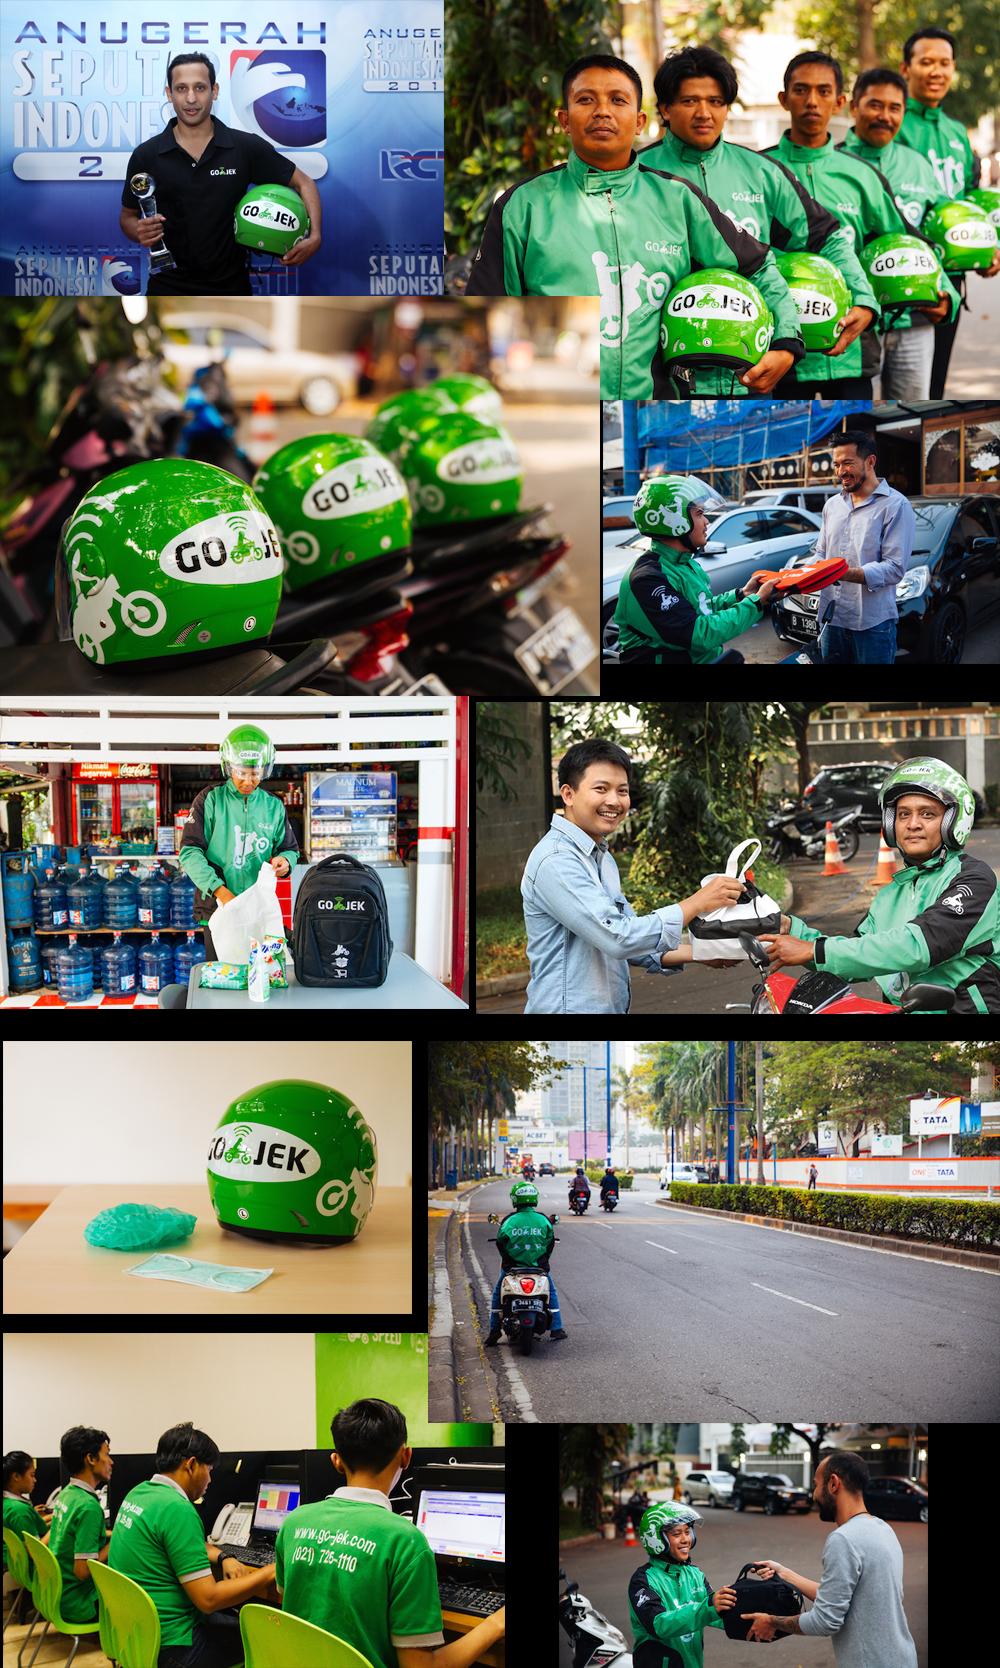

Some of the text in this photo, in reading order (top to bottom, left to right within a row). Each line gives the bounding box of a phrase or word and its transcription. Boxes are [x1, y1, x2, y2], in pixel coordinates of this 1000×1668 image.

[15, 21, 327, 44] ANUGERAH
[274, 211, 297, 229] JEK
[15, 256, 98, 276] SEPUTAR
[369, 256, 444, 274] SEPUTA
[875, 257, 895, 272] GO
[15, 278, 96, 296] INDONESIA
[672, 294, 752, 317] GO JEK
[803, 299, 831, 317] JEK
[312, 482, 350, 512] GO
[175, 536, 227, 573] GO
[318, 900, 366, 911] GO JEK
[789, 999, 814, 1010] HONDA
[923, 1116, 948, 1124] TATA
[253, 1141, 310, 1174] JEK
[937, 1168, 955, 1176] TATA
[294, 1527, 377, 1556] www.go-jek.com
[291, 1546, 358, 1573] (021) 725-1110
